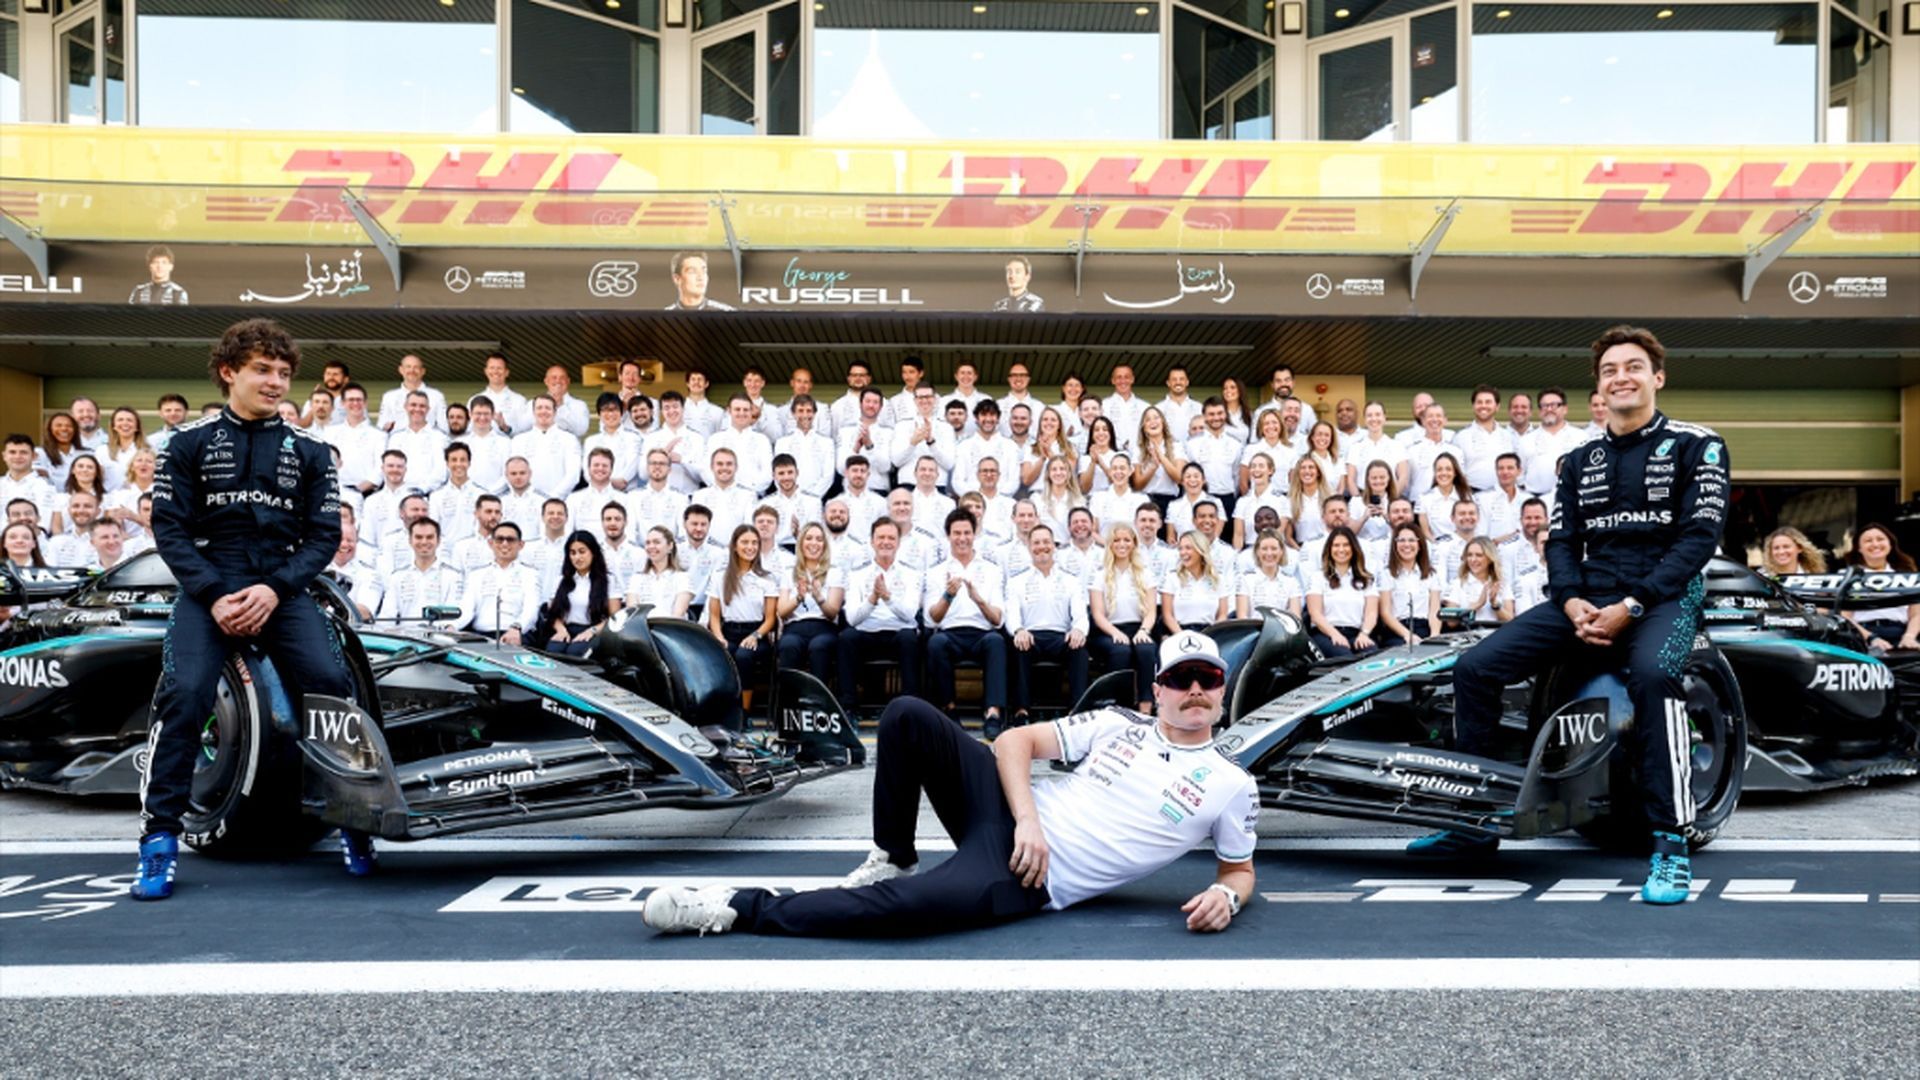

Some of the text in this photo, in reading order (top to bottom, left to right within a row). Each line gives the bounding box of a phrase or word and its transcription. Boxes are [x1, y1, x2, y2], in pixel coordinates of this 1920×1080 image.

[273, 150, 646, 226] DHL
[931, 156, 1291, 231] DHL
[1576, 161, 1920, 234] DHL
[588, 261, 640, 297] 63
[783, 256, 850, 302] George
[742, 287, 924, 305] RUSSELL
[206, 489, 294, 511] PETRONAS
[1585, 510, 1673, 530] PETRONAS
[1782, 575, 1920, 589] PETON
[541, 696, 597, 731] Einhell
[783, 708, 842, 734] INEOS
[1322, 699, 1374, 722] Einhell
[308, 709, 361, 744] IWC
[1556, 713, 1606, 746] IWC
[443, 748, 530, 771] PETRONAS
[1394, 751, 1480, 774] PETRONAS
[447, 767, 535, 796] Syntium
[1387, 767, 1475, 796] Syntium
[1352, 879, 1869, 902] DHL
